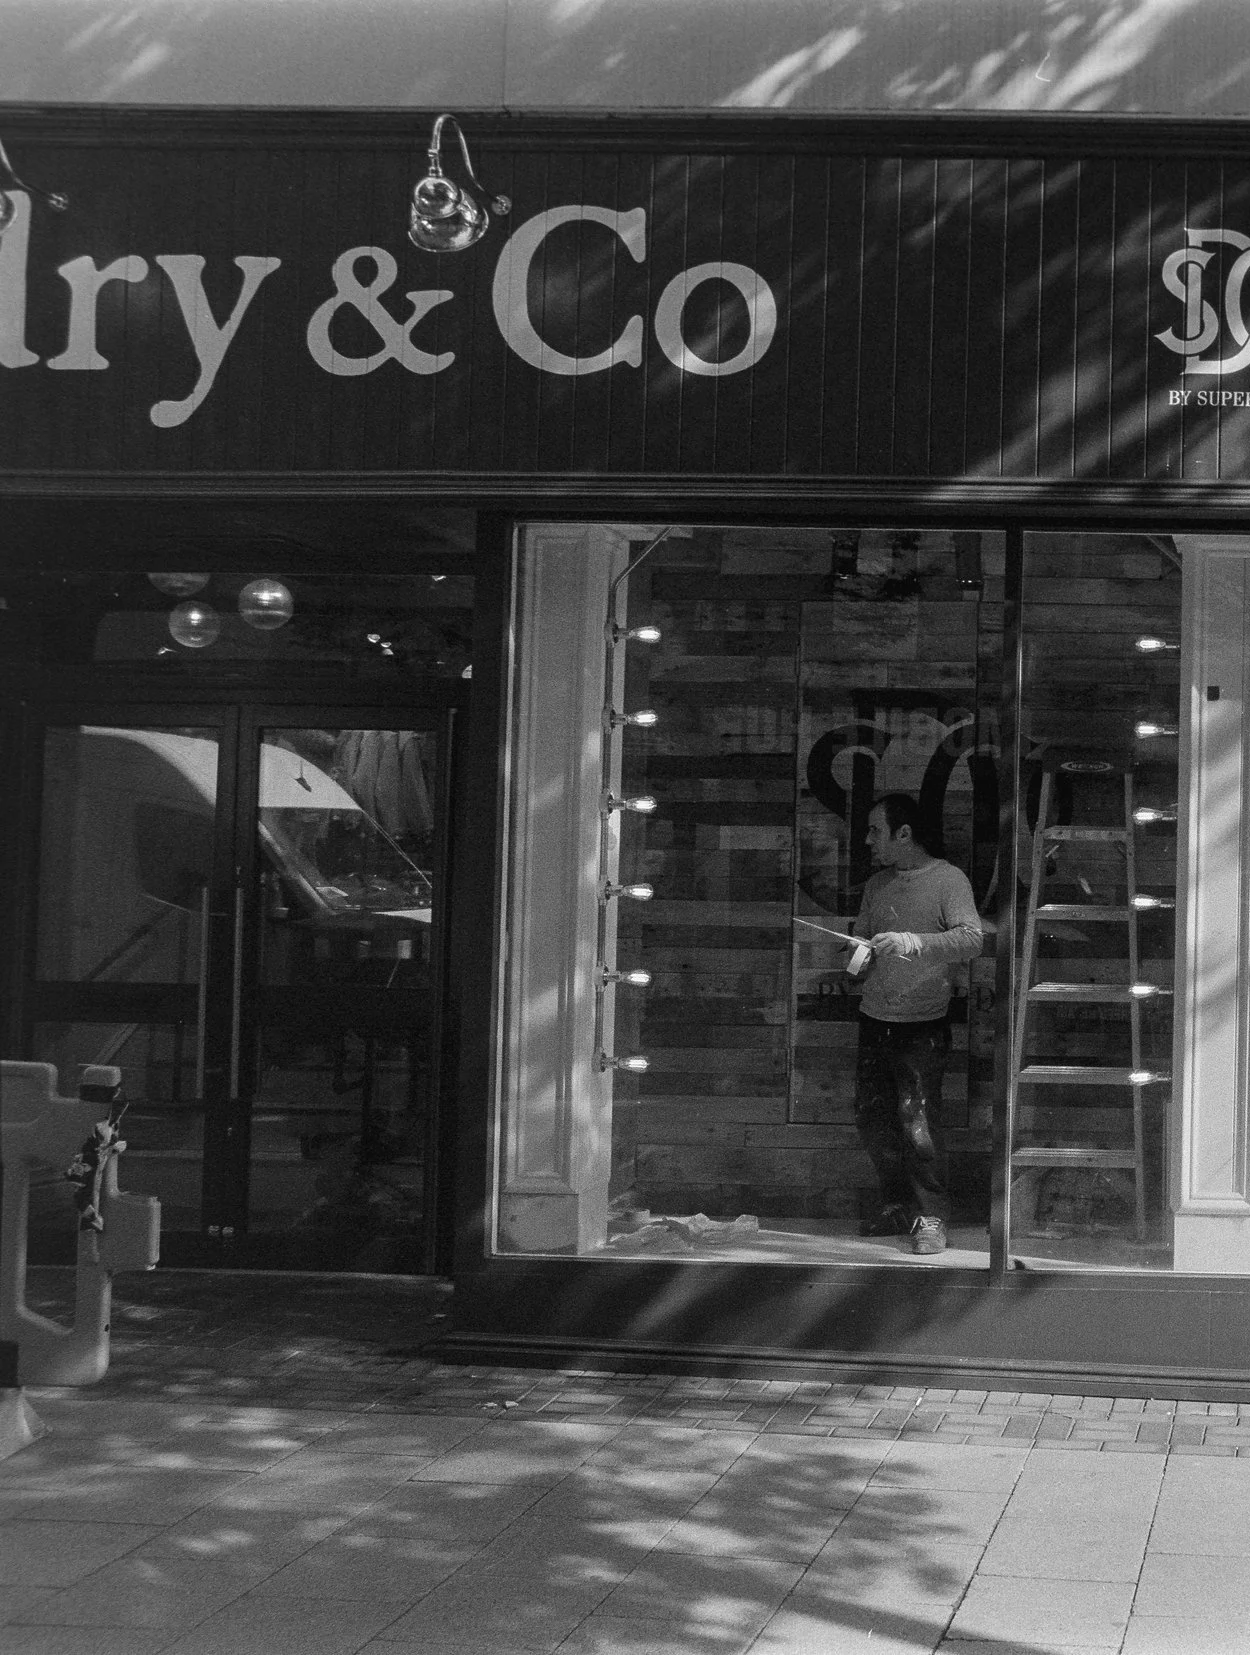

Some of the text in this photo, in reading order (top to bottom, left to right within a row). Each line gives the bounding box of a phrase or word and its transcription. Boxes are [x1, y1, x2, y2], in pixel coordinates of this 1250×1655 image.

[307, 246, 456, 375] &
[492, 204, 778, 376] Co
[1168, 390, 1192, 406] BY
